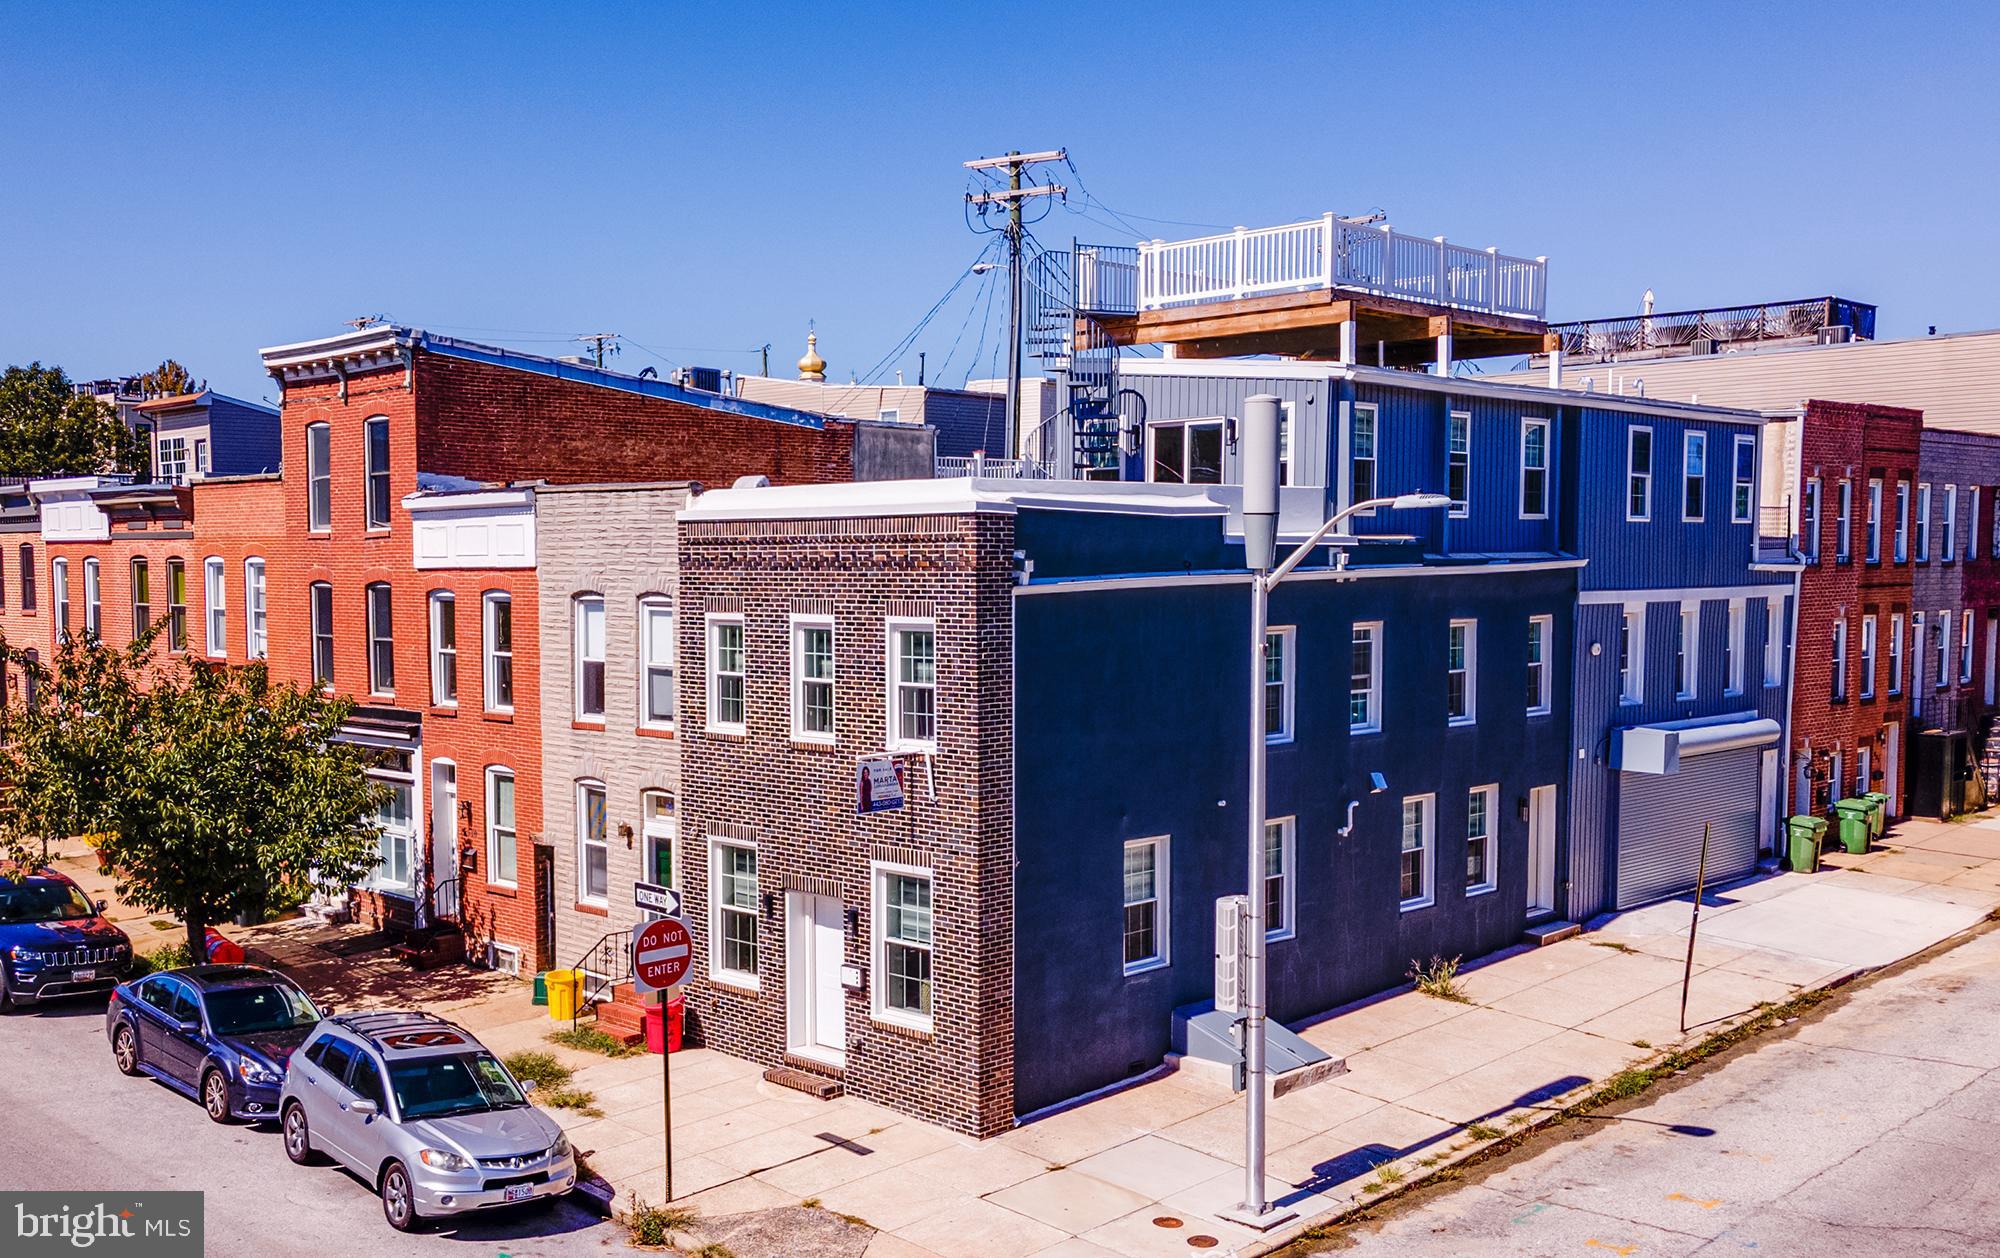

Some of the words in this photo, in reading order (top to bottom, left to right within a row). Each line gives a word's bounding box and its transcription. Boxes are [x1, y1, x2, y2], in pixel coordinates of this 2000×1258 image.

[873, 775, 897, 784] MARTA
[639, 891, 653, 904] ONE
[654, 894, 667, 906] WAY
[643, 935, 657, 948] DO
[663, 930, 683, 944] NOT
[648, 962, 680, 978] ENTER
